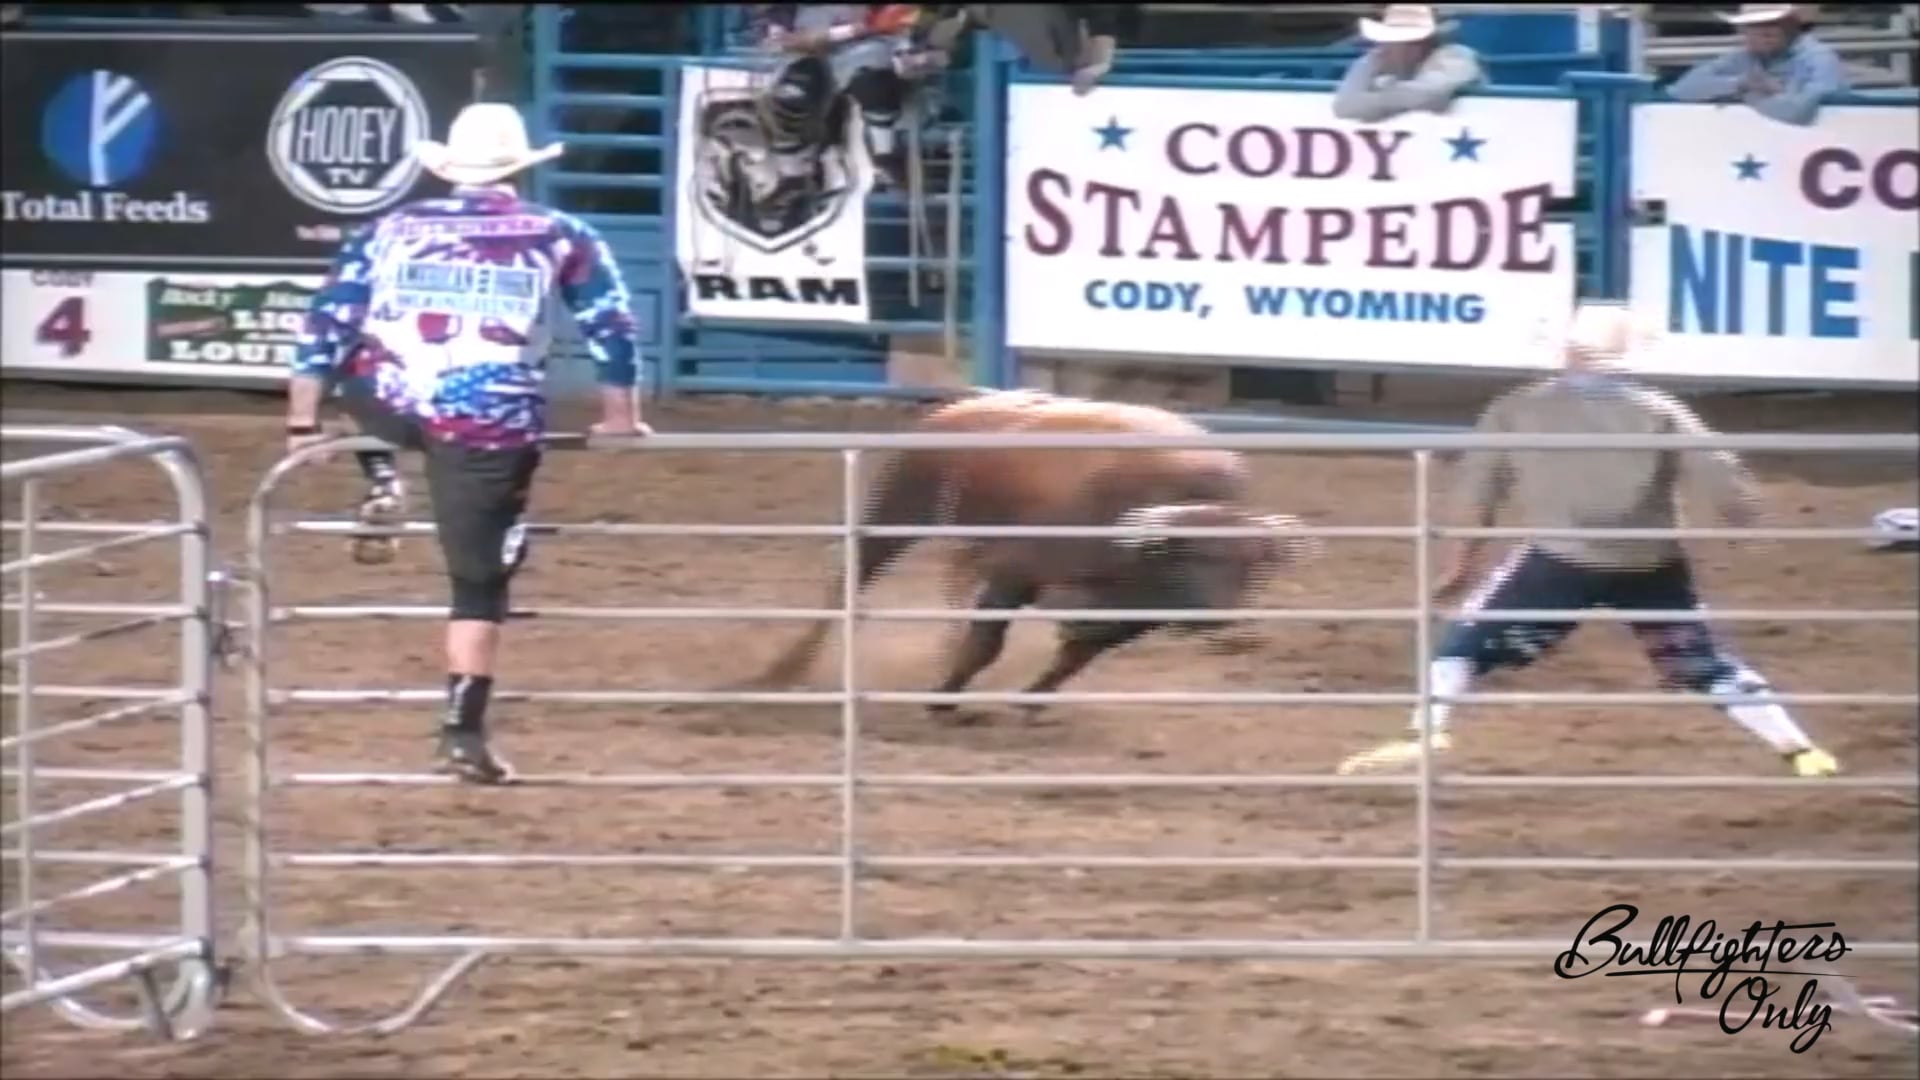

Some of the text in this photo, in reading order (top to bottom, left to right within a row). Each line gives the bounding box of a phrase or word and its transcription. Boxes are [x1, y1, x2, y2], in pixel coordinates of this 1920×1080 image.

[296, 105, 397, 163] HOOEY
[1165, 122, 1413, 182] CODY
[326, 168, 368, 185] TV
[1, 190, 210, 223] Total Feeds
[1024, 167, 1555, 273] STAMPEDE
[693, 274, 860, 306] RAM
[1084, 279, 1486, 323] CODY, WYOMING
[1669, 223, 1860, 338] NITE
[36, 297, 91, 357] 4
